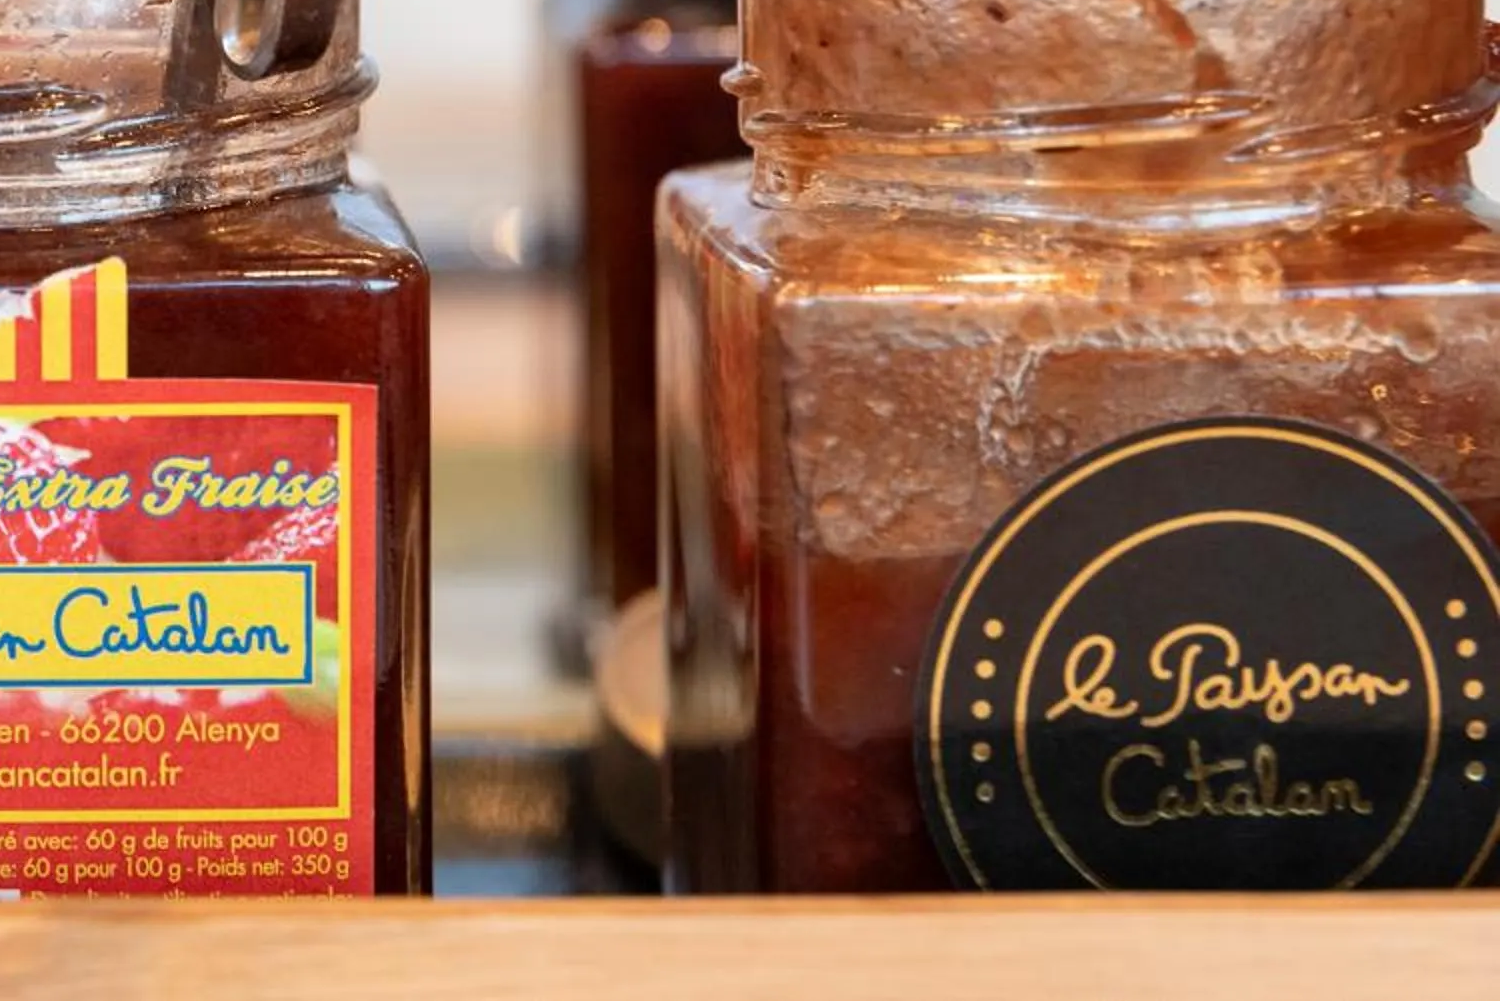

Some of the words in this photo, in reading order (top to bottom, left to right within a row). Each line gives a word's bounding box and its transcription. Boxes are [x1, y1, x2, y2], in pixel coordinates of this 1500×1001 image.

[142, 455, 340, 516] Fraise
[53, 584, 290, 659] Catalan
[1046, 634, 1139, 721] le
[1140, 623, 1410, 727] Paysan
[60, 714, 165, 744] 66200
[175, 713, 280, 751] Alenya
[1103, 738, 1373, 827] Catalan
[23, 835, 79, 850] avec:
[85, 829, 116, 850] 60
[121, 835, 136, 855] g
[143, 828, 169, 849] de
[176, 827, 223, 849] fruits
[230, 833, 277, 854] pour
[286, 827, 328, 848] 100
[333, 832, 348, 852] g
[23, 858, 50, 878] 60
[56, 863, 69, 883] g
[75, 862, 117, 883] pour
[126, 857, 163, 878] 100
[168, 861, 182, 882] g
[197, 855, 247, 877] Poids
[252, 856, 284, 876] net:
[291, 854, 331, 875] 350
[336, 858, 350, 879] g
